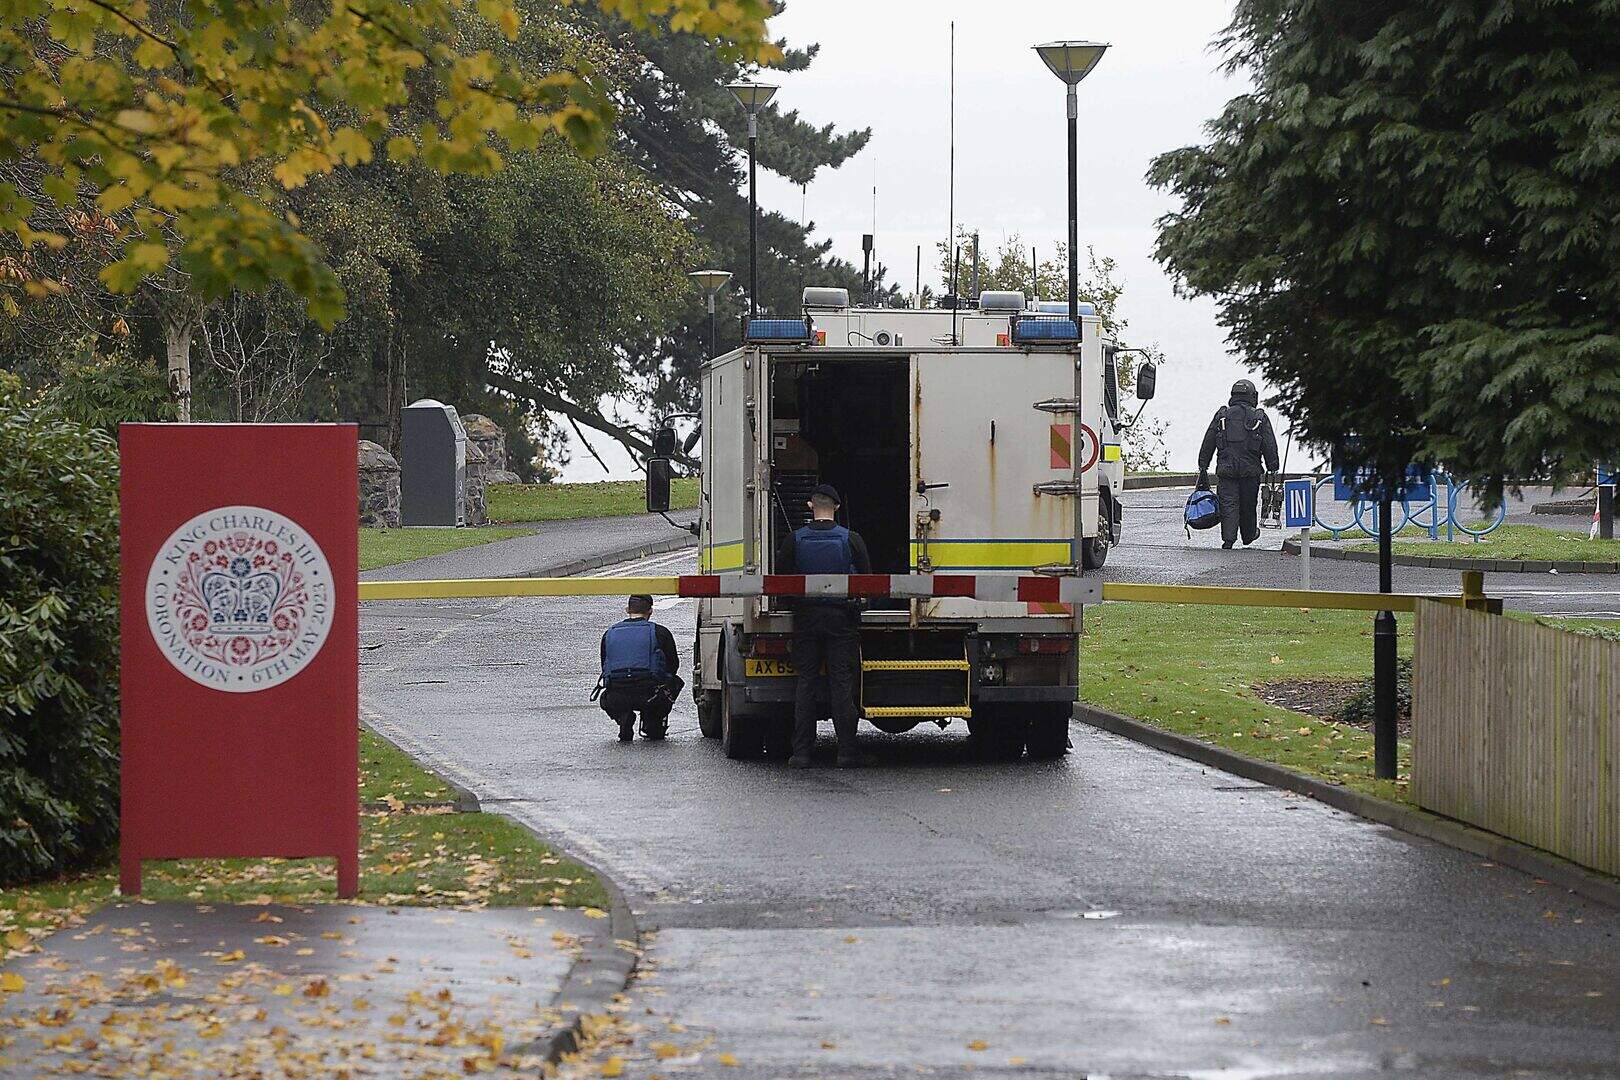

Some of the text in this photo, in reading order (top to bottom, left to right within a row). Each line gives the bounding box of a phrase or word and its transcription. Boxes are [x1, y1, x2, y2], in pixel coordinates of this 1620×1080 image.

[1290, 489, 1307, 519] IN
[165, 514, 316, 566] KING CHARLES III
[154, 582, 231, 683] CORONATION
[252, 582, 328, 683] 6TH MAY 2023
[755, 660, 773, 674] AX
